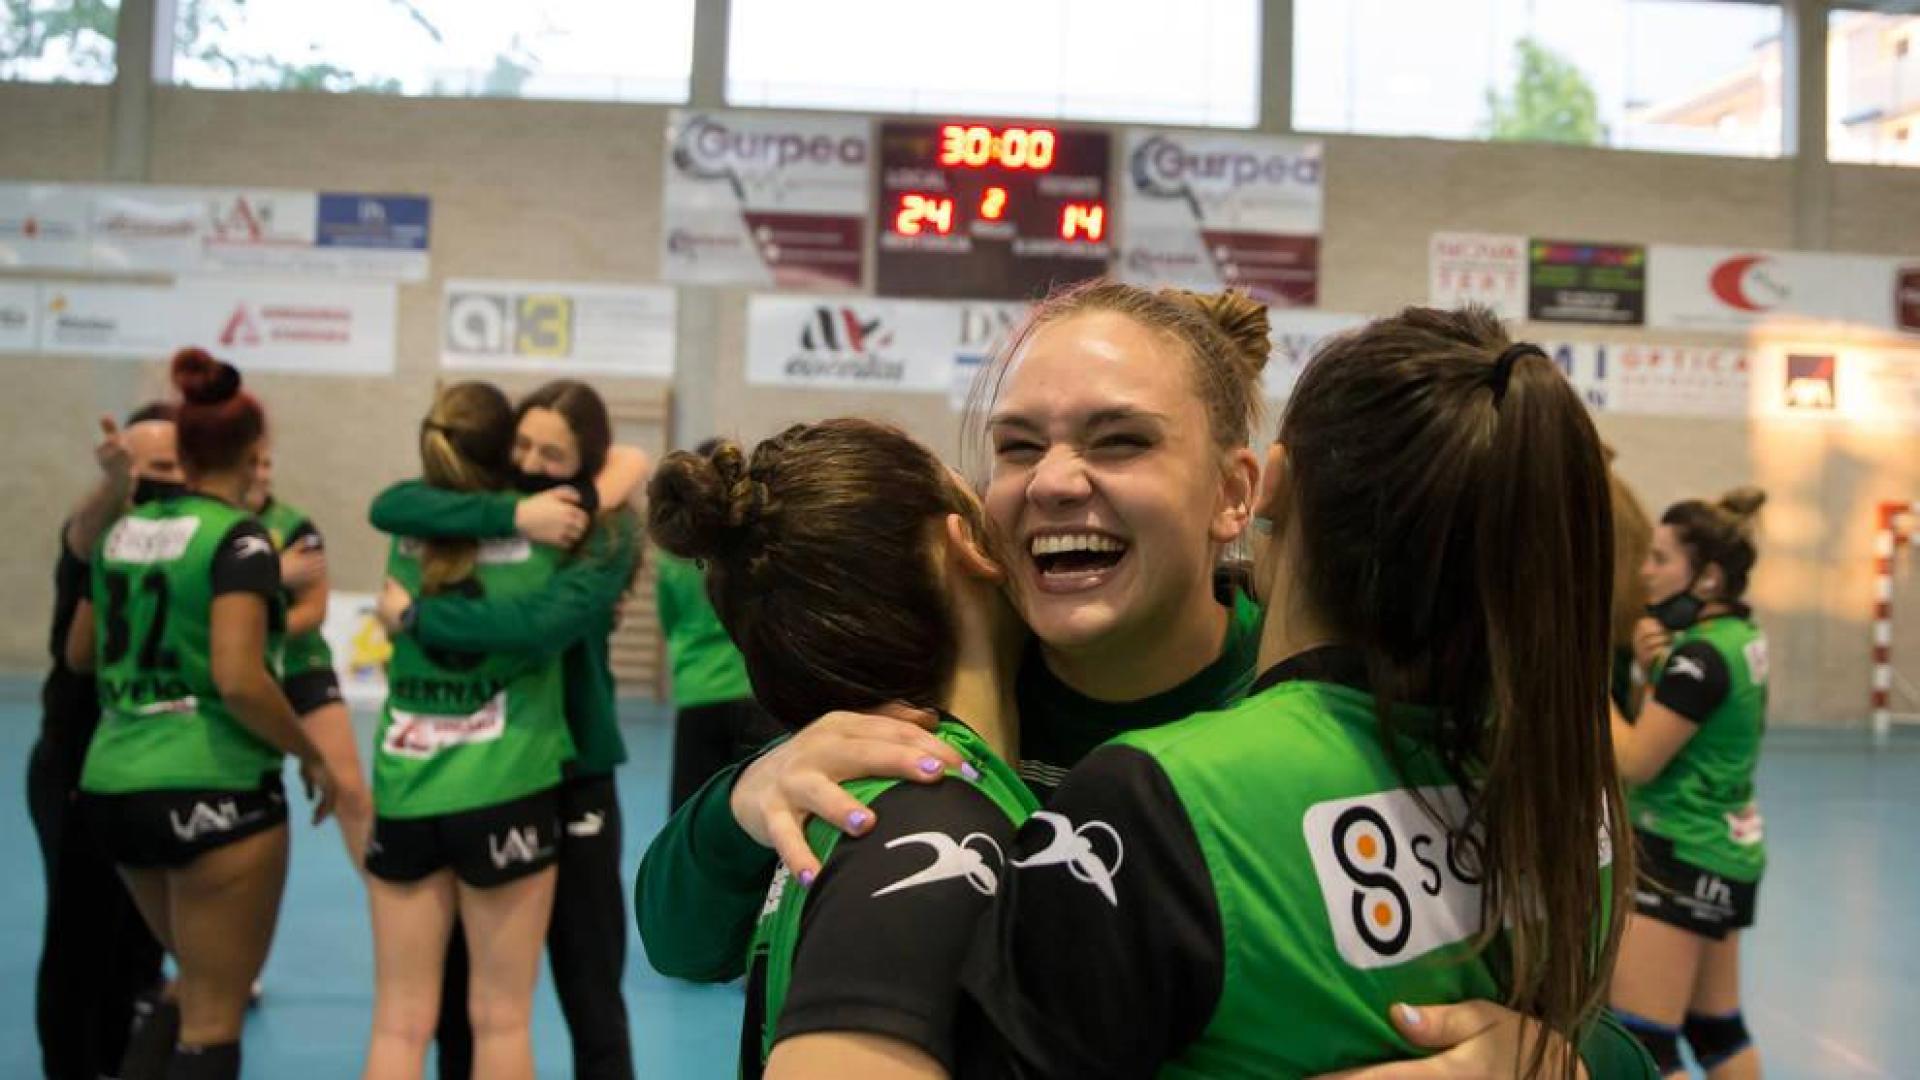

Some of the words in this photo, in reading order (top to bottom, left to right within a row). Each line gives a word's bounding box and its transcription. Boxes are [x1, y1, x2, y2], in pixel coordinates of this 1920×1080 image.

[940, 124, 1055, 170] 30:00
[897, 192, 954, 235] 24
[980, 186, 1007, 219] 2
[1061, 203, 1104, 241] 14
